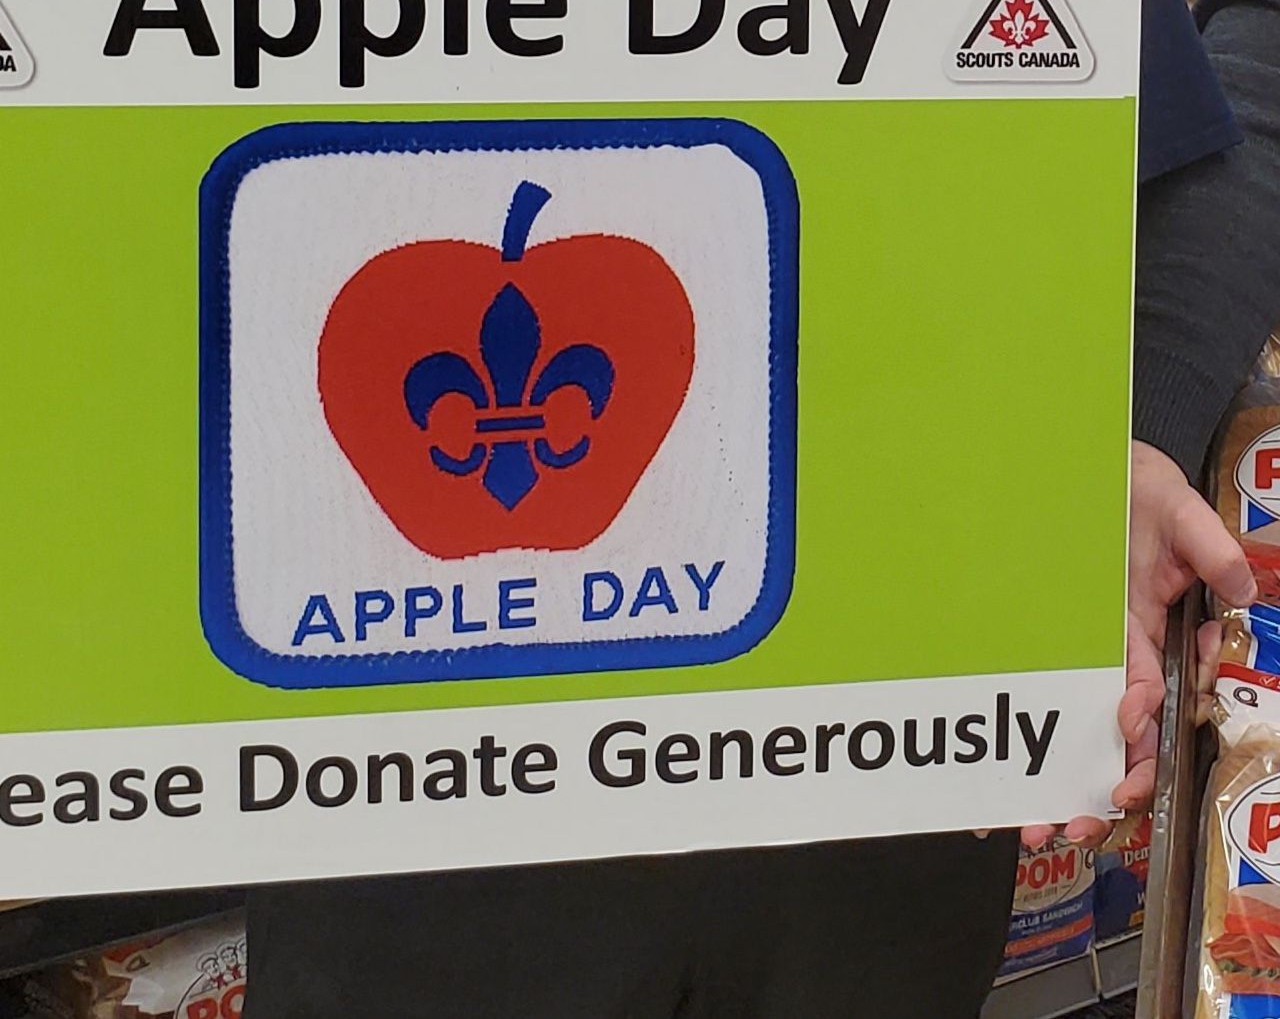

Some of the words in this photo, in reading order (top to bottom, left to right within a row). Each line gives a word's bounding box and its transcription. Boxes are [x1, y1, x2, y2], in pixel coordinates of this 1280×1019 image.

[956, 51, 1014, 69] SCOUTS
[1017, 51, 1081, 69] CANADA
[291, 578, 537, 647] APPLE
[582, 561, 726, 622] DAY
[239, 735, 558, 812] Donate
[588, 693, 1060, 788] Generously
